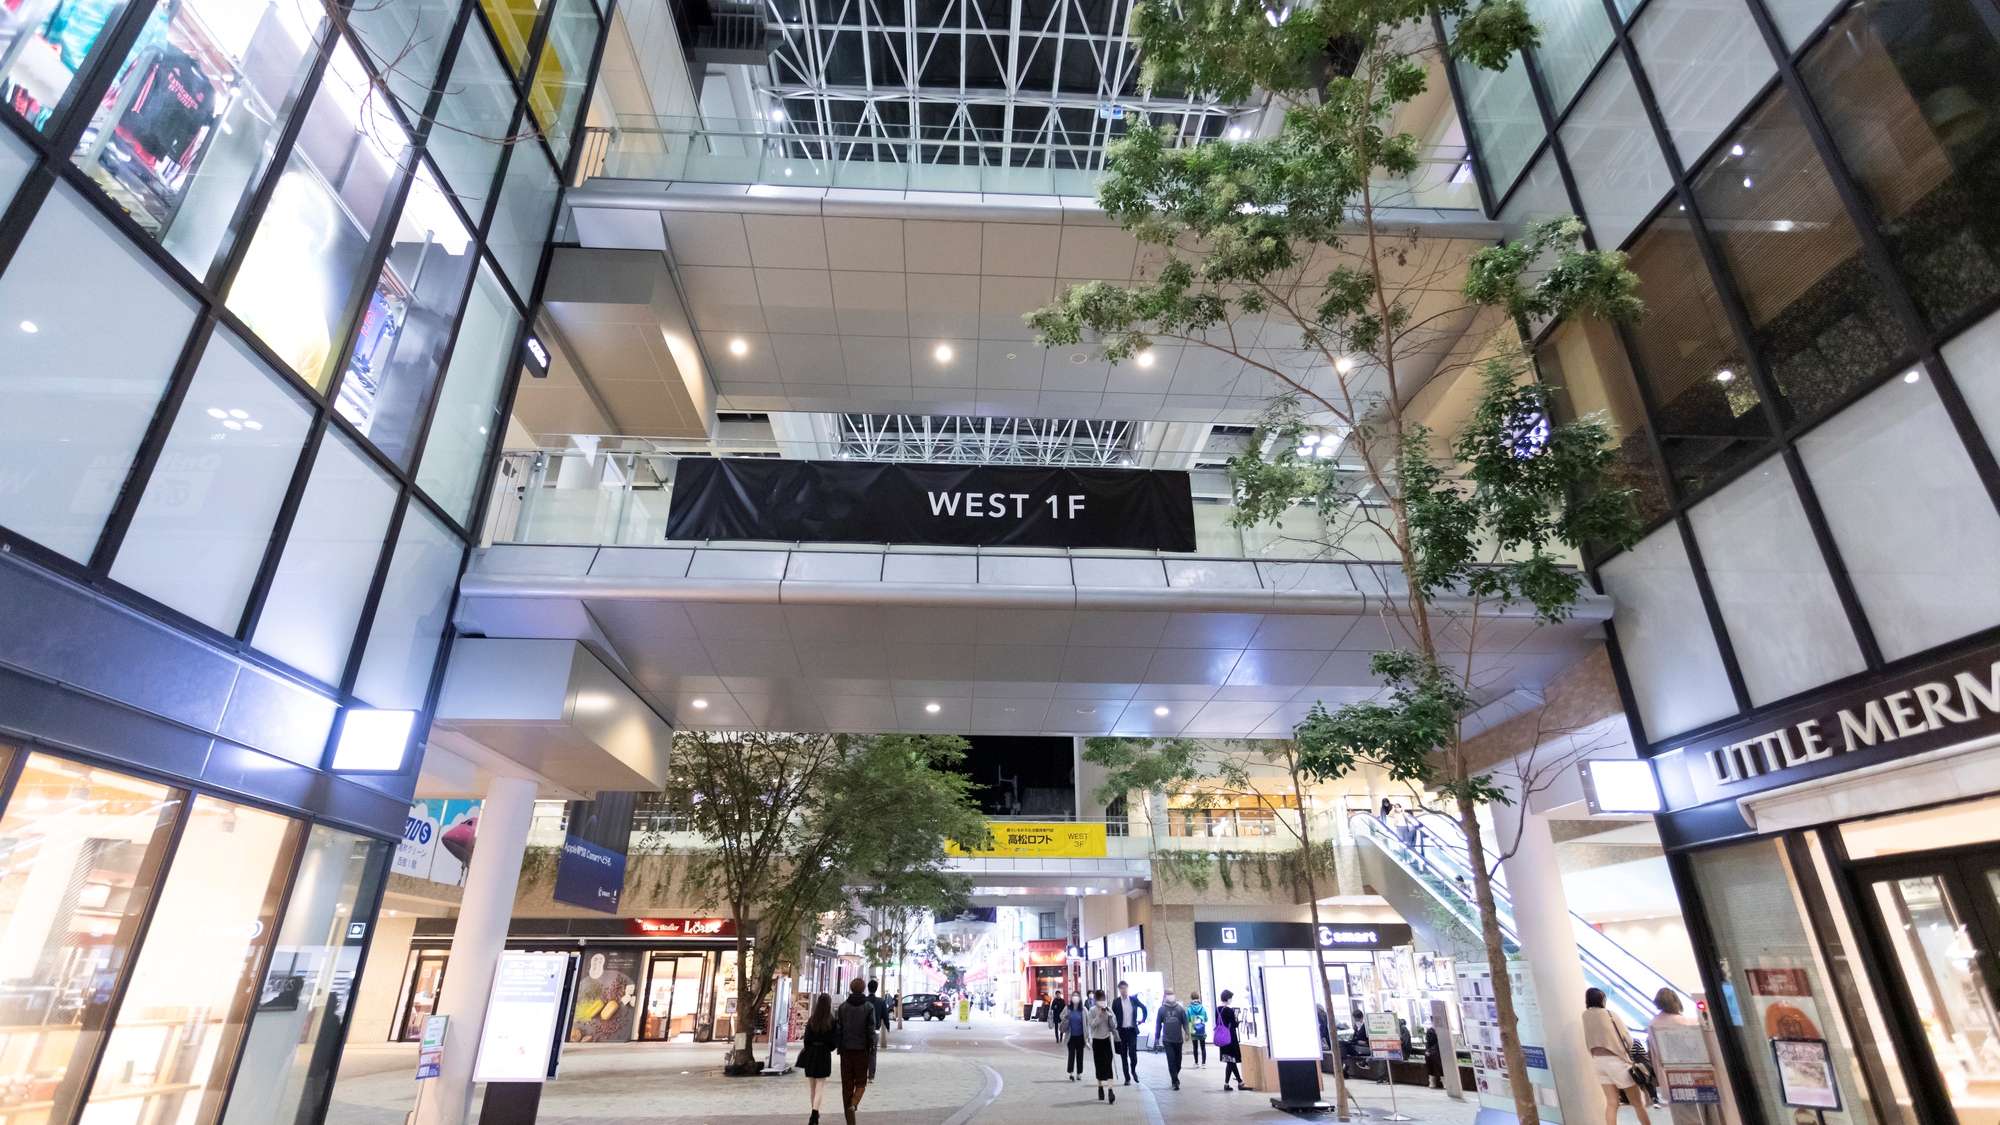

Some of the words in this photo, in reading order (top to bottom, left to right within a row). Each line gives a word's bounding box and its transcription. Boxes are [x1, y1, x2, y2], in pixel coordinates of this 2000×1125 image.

[928, 491, 1029, 519] WEST
[1045, 494, 1085, 519] 1F
[1704, 718, 1833, 786] LITTLE
[1008, 834, 1053, 845] 高松ロフト
